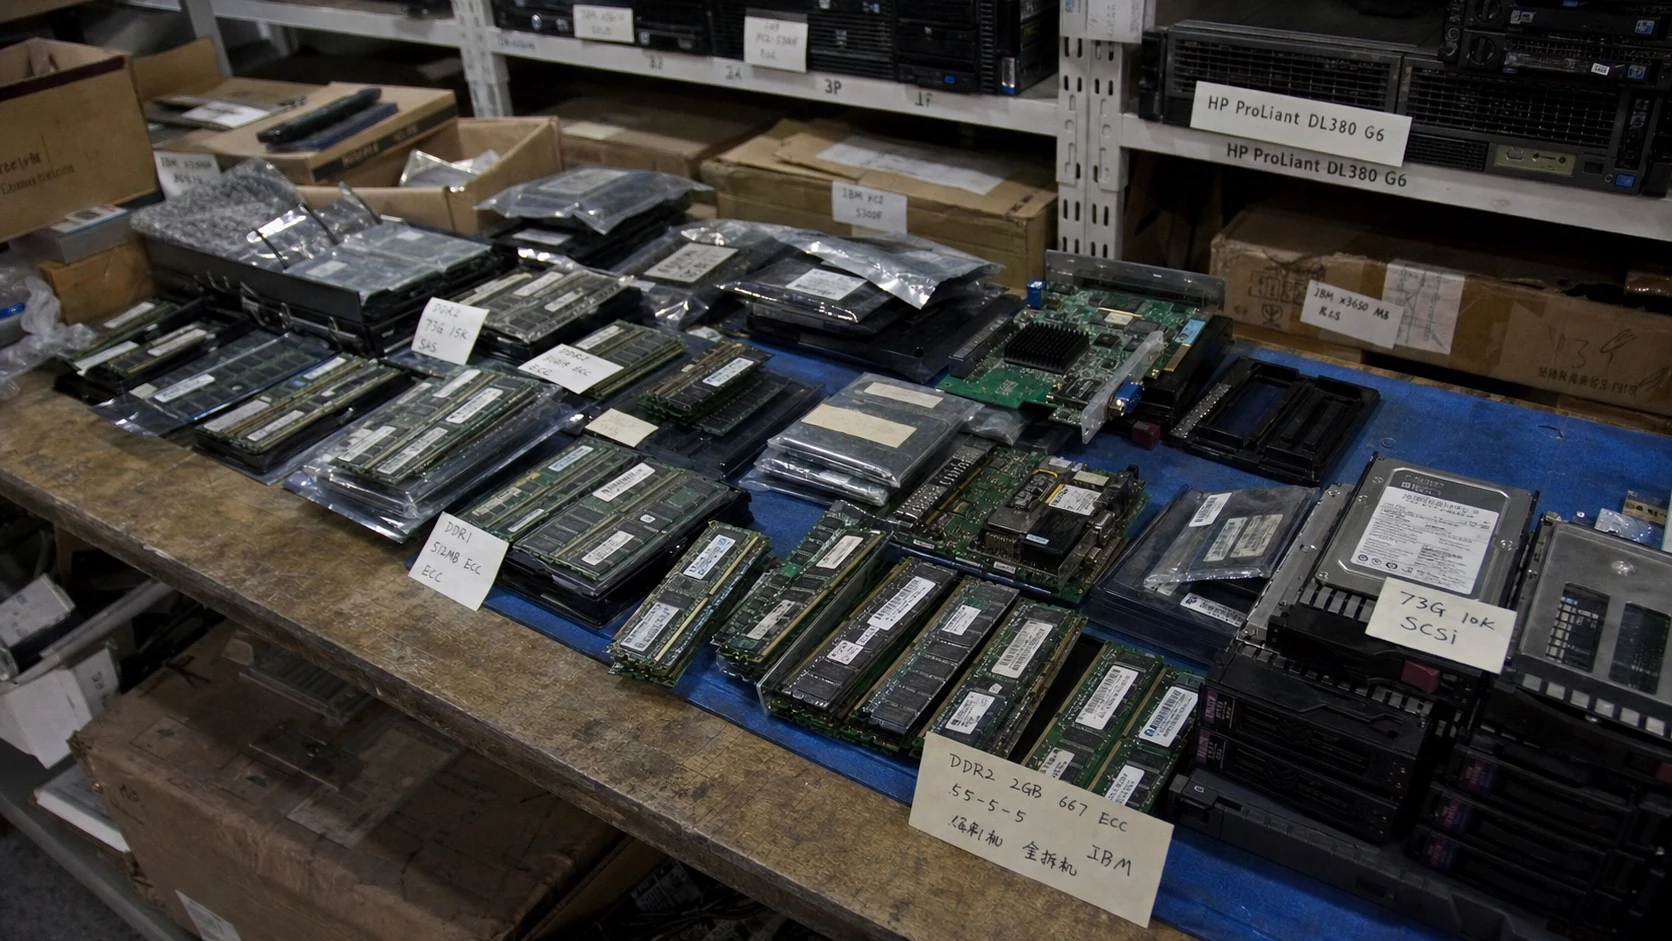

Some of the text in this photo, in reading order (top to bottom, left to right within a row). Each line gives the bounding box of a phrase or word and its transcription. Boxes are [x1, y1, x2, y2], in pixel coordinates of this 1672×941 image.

[824, 78, 842, 95] 3P
[1208, 95, 1385, 142] HP ProLiant DL380 G6
[1226, 142, 1407, 188] HP ProLiant DL380 G6
[842, 187, 863, 202] IBM
[1314, 287, 1334, 302] IBM
[1339, 297, 1369, 312] x3650
[449, 326, 469, 341] 15K
[444, 521, 473, 544] DDR1
[430, 541, 483, 576] 512MB ECC
[421, 564, 443, 583] ECC
[1400, 591, 1447, 618] 73G
[949, 752, 1128, 833] DDR2 2GB 667 ECC
[1086, 844, 1132, 877] IBM
